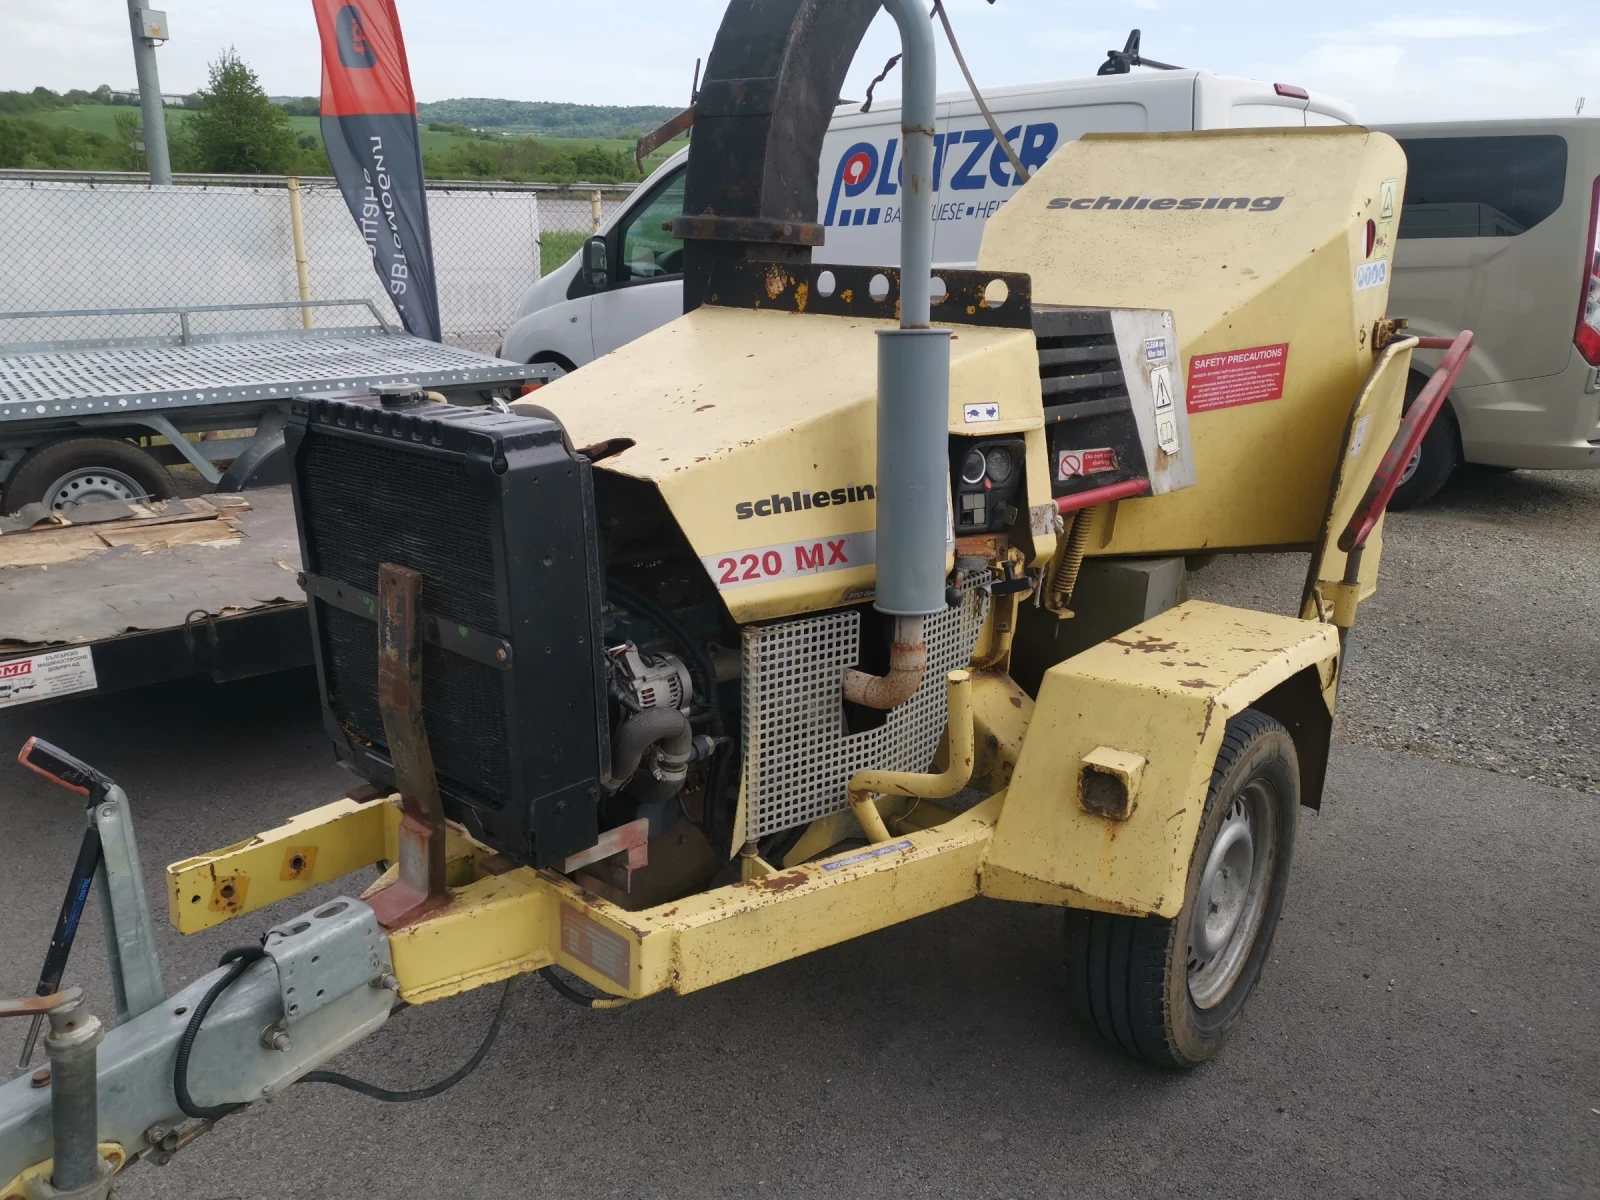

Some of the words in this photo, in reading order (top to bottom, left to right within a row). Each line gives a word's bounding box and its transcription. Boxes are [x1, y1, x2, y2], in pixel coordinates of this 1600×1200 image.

[823, 122, 1059, 227] PLTZER
[931, 202, 964, 222] LIESE
[1045, 194, 1285, 212] schliesing
[1194, 356, 1226, 369] SAFETY
[1227, 348, 1283, 365] PRECAUTIONS
[735, 482, 877, 520] schliesin
[717, 550, 783, 585] 220
[794, 539, 849, 572] MX
[45, 650, 79, 661] БЪЛГАРСКО
